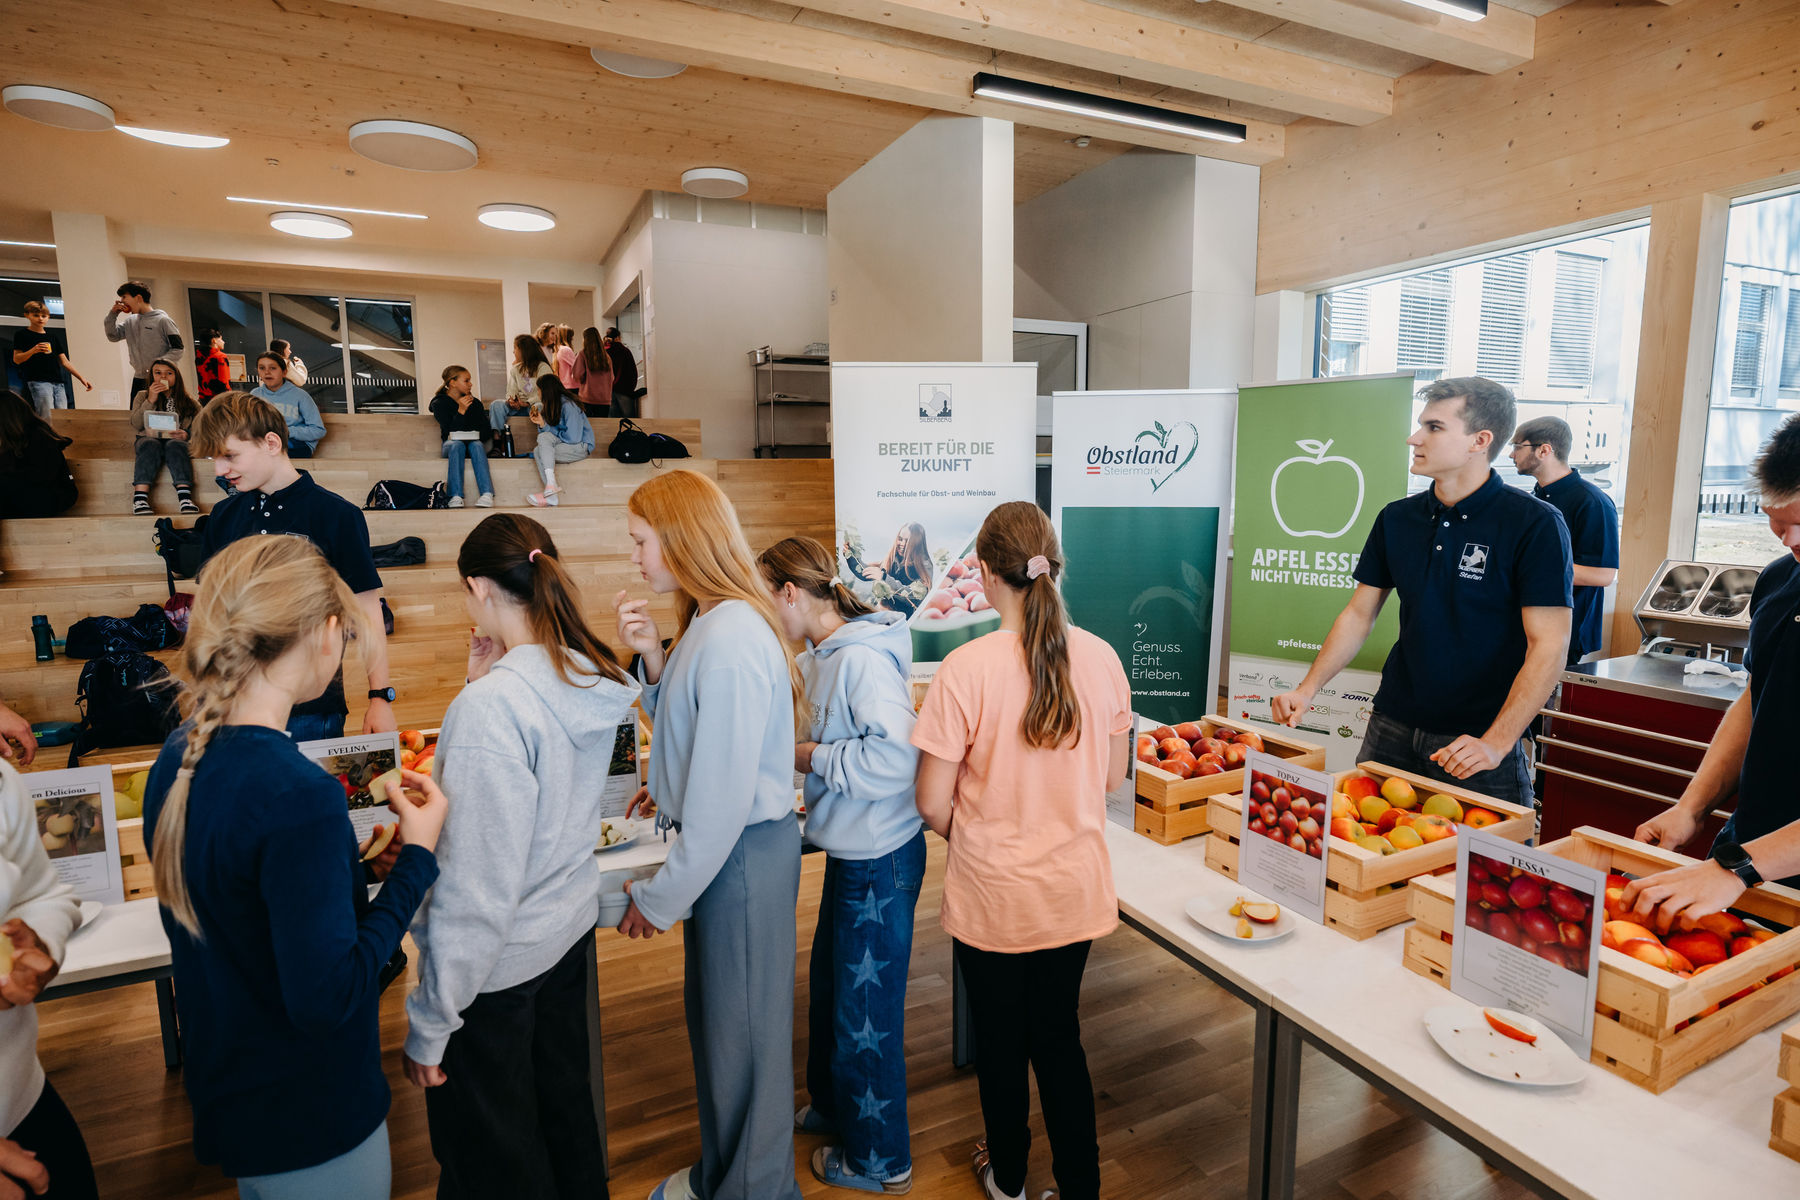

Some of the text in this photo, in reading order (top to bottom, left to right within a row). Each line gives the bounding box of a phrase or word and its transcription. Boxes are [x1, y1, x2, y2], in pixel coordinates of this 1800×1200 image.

[878, 439, 995, 456] BEREIT FÜR DIE
[1086, 444, 1179, 465] Obstland
[901, 458, 972, 472] ZUKUNFT
[1104, 466, 1161, 476] Steiermark
[877, 490, 917, 498] Fachschule
[966, 489, 996, 497] Weinbau
[1252, 548, 1362, 573] APFEL ESSE
[1251, 568, 1360, 589] NICHT VERGESS
[1132, 640, 1183, 653] Genuss.
[1277, 639, 1322, 651] apfelesse
[1132, 655, 1163, 666] Echt.
[1131, 668, 1182, 680] Erleben.
[1341, 693, 1370, 702] ZORN
[1276, 769, 1301, 785] TOPAZ
[45, 787, 87, 797] Delicious
